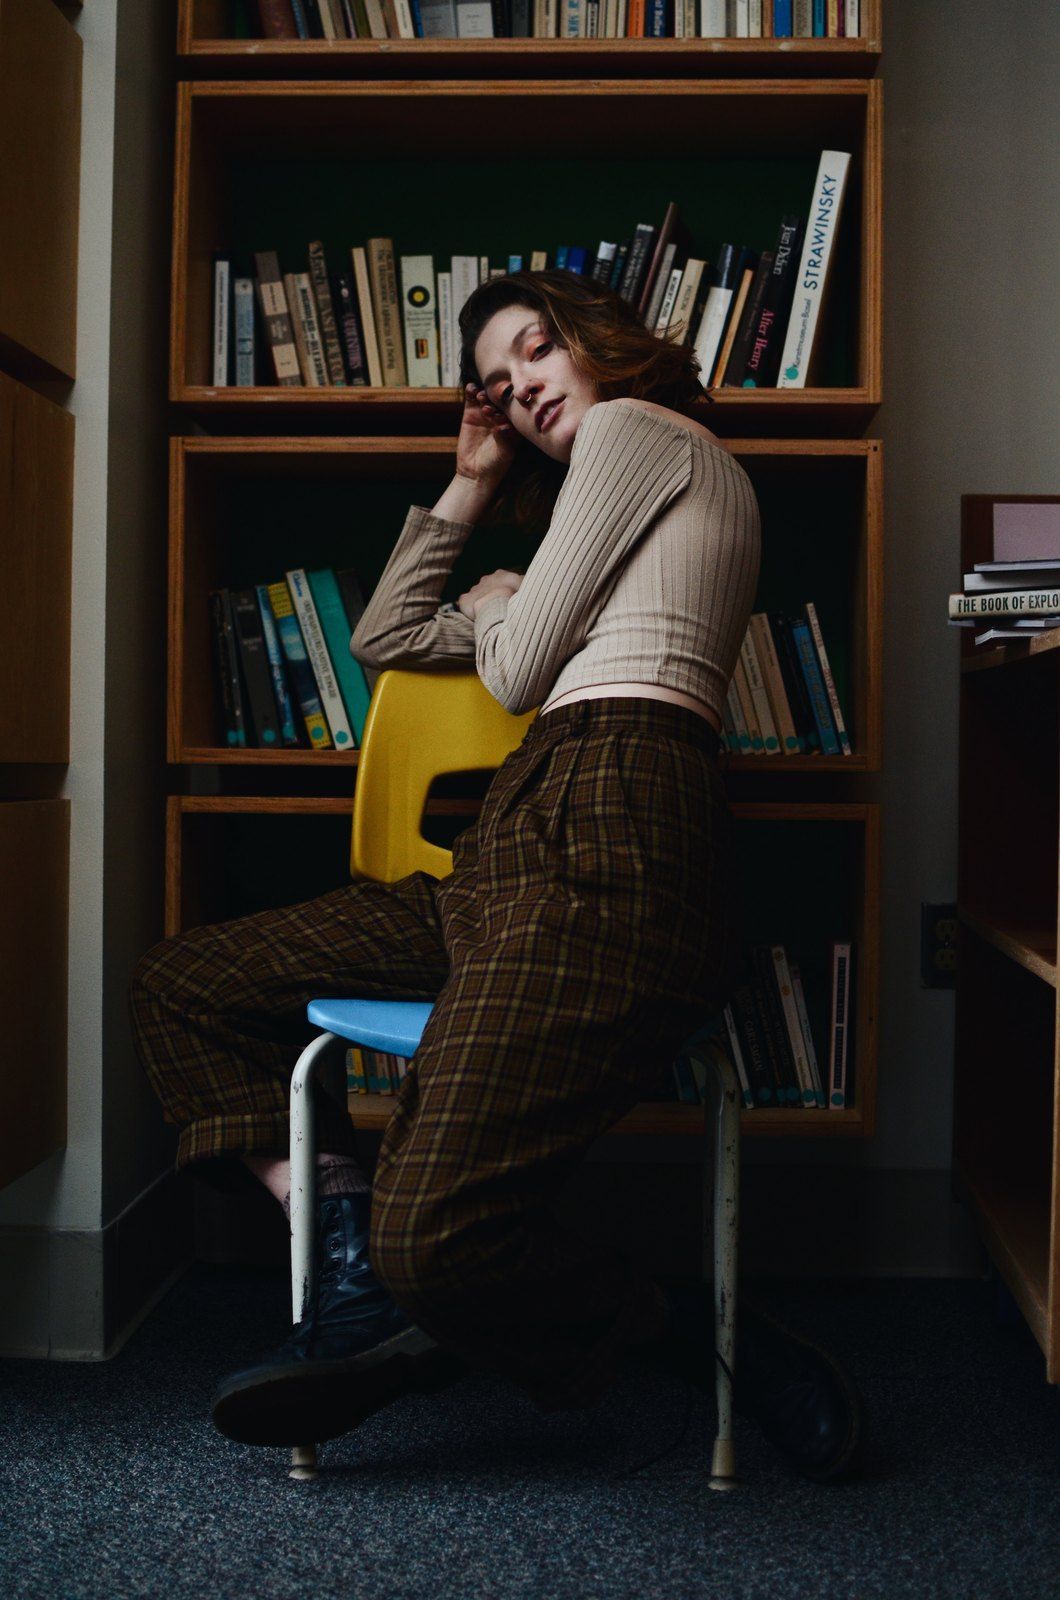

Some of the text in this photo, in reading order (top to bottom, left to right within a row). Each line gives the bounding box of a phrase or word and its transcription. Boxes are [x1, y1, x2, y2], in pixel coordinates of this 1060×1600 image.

[803, 173, 838, 291] STRAWINSKY
[757, 307, 777, 338] After
[802, 298, 813, 320] Basel
[747, 334, 770, 371] Henry
[958, 593, 1060, 613] THE BOOK OF EXPLO
